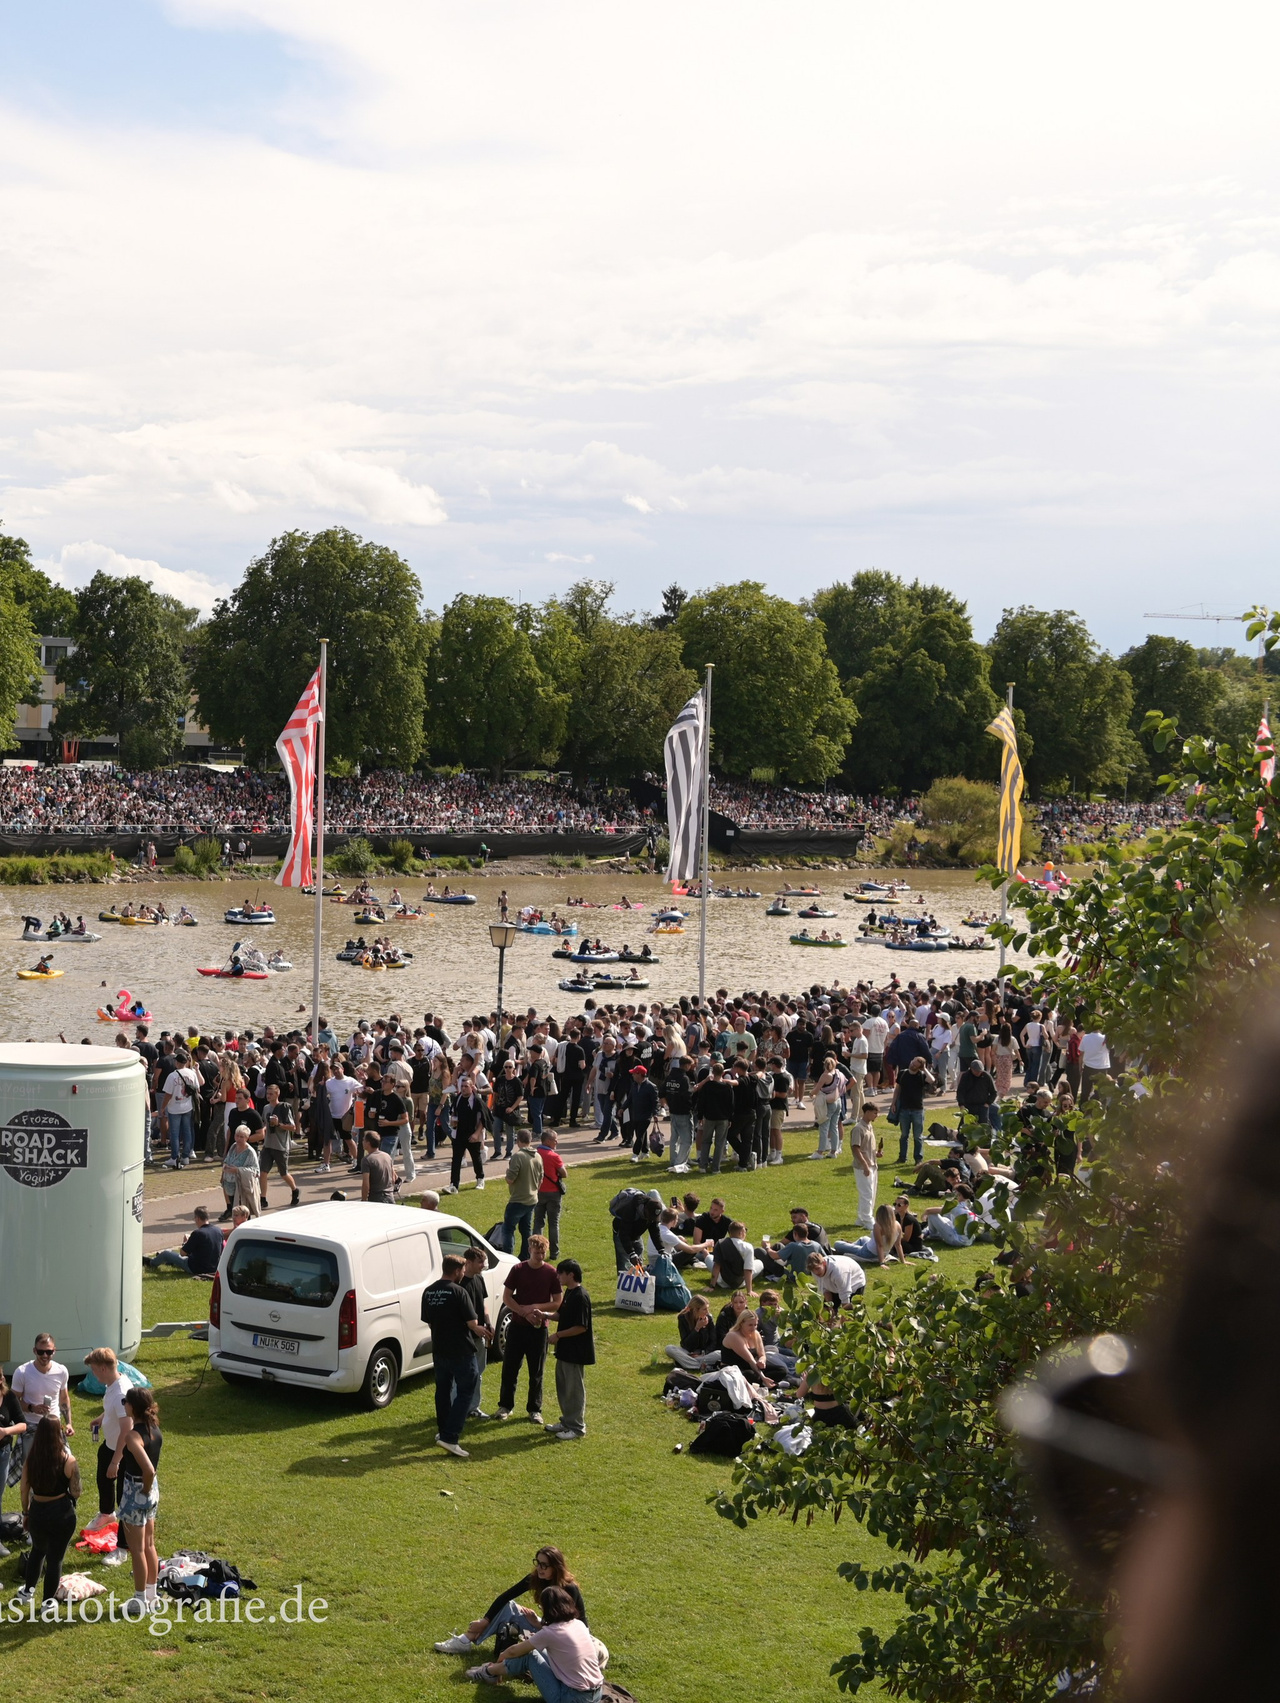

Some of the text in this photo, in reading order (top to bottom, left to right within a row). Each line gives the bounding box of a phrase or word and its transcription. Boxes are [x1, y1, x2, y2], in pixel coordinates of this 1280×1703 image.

[22, 1115, 59, 1125] Frozen
[1, 1130, 56, 1149] ROAD
[12, 1147, 79, 1165] SHACK
[20, 1169, 56, 1186] Yogurt
[621, 1298, 642, 1308] ACTION
[260, 1337, 270, 1346] NU
[281, 1341, 295, 1351] 505
